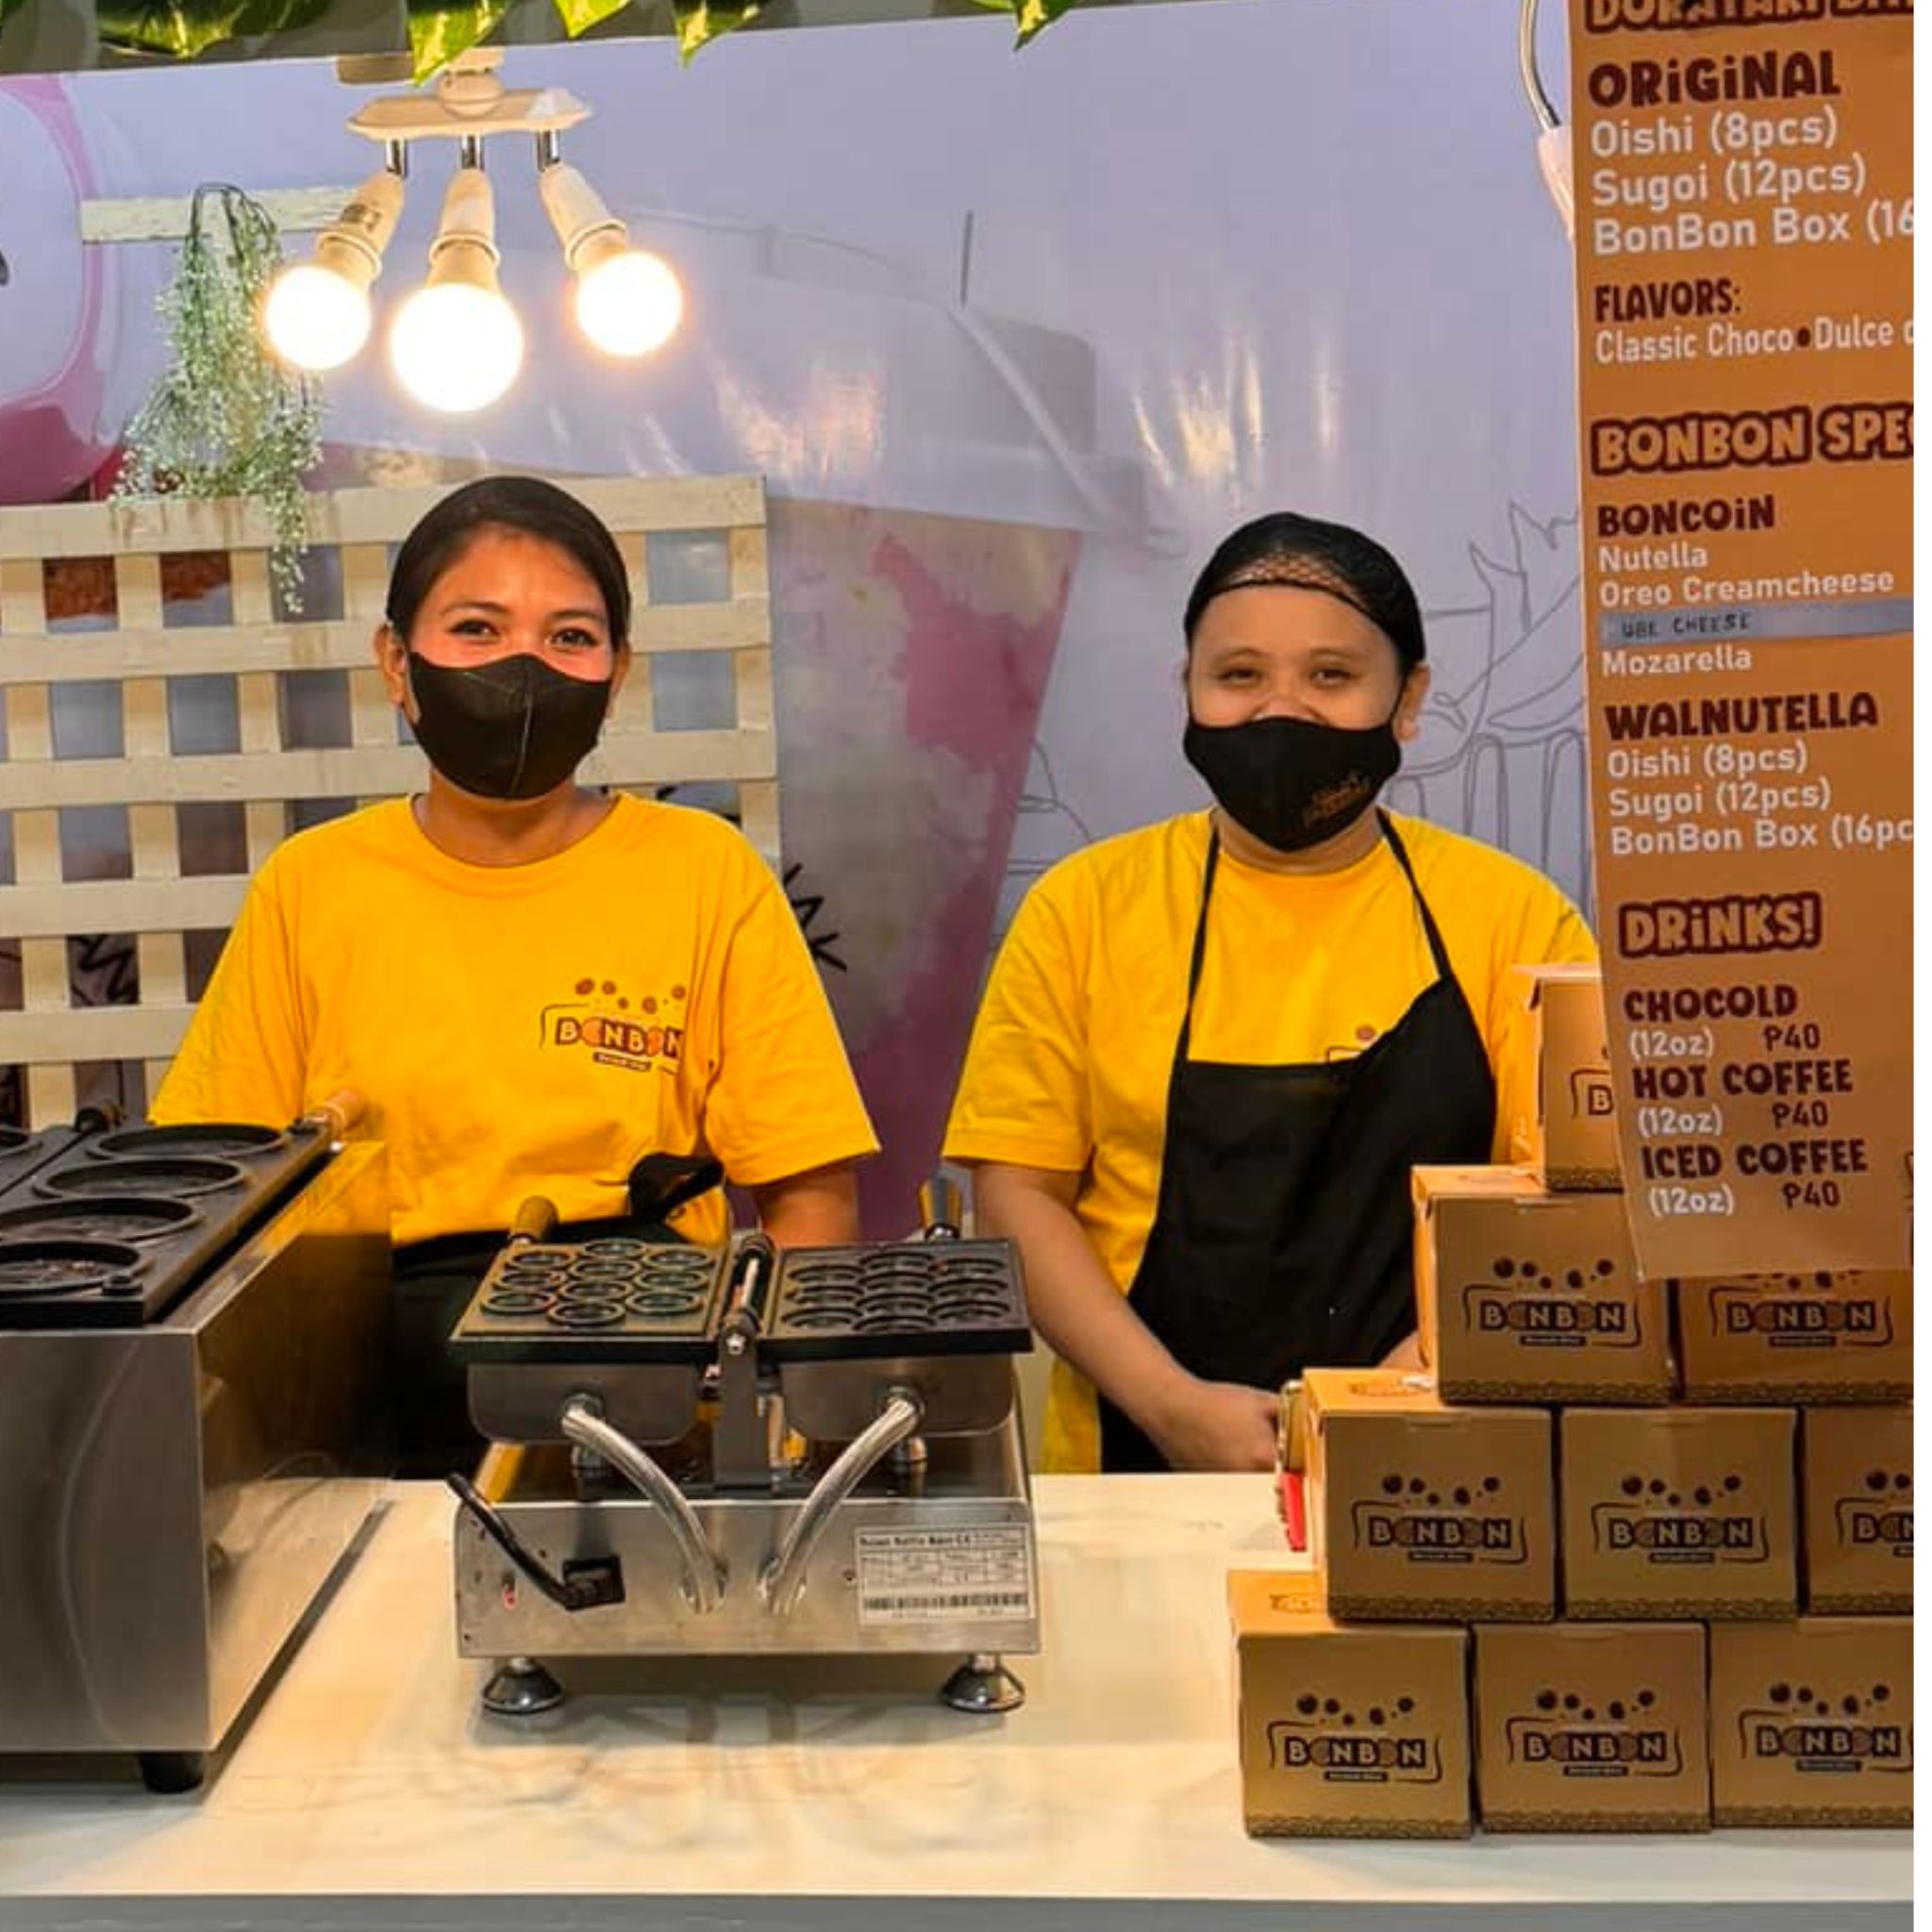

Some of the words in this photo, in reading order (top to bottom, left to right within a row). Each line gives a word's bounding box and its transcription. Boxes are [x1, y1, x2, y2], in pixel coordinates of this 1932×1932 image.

[1591, 115, 1693, 157] Oishi
[1710, 104, 1838, 156] (8pcs)
[1592, 163, 1707, 211] Sugoi
[1725, 152, 1866, 203] (12pcs)
[1593, 212, 1756, 256] BonBon
[1773, 208, 1850, 243] Box
[1595, 277, 1741, 322] FLAVORS:
[1595, 325, 1697, 363] Classic
[1707, 322, 1794, 357] Choco
[1814, 313, 1893, 350] Dulce
[1591, 406, 1811, 475] BONBON
[1819, 402, 1913, 461] SPE
[1599, 541, 1708, 573] Nutella
[1600, 580, 1672, 608] Oreo
[1683, 569, 1893, 603] Creamcheese
[1674, 612, 1751, 633] CHEESE
[1602, 643, 1752, 677] Mozarella
[1605, 691, 1878, 741] WALNUTELLA
[1608, 746, 1690, 779] Oishi
[1703, 738, 1808, 779] (8pcs)
[1609, 785, 1703, 823] Sugoi
[1716, 776, 1831, 817] (12pcs)
[1611, 823, 1742, 856] BonBon
[1756, 820, 1818, 848] Box
[1831, 812, 1913, 850] (16pc
[1624, 985, 1798, 1023] CHOCOLD
[1628, 1026, 1714, 1060] (12oz)
[1633, 1065, 1707, 1100] HOT
[1723, 1058, 1853, 1095] COFFEE
[1638, 1105, 1723, 1138] (12oz)
[1641, 1143, 1722, 1179] ICED
[1737, 1140, 1868, 1175] COFFEE
[1649, 1184, 1735, 1218] (12oz)
